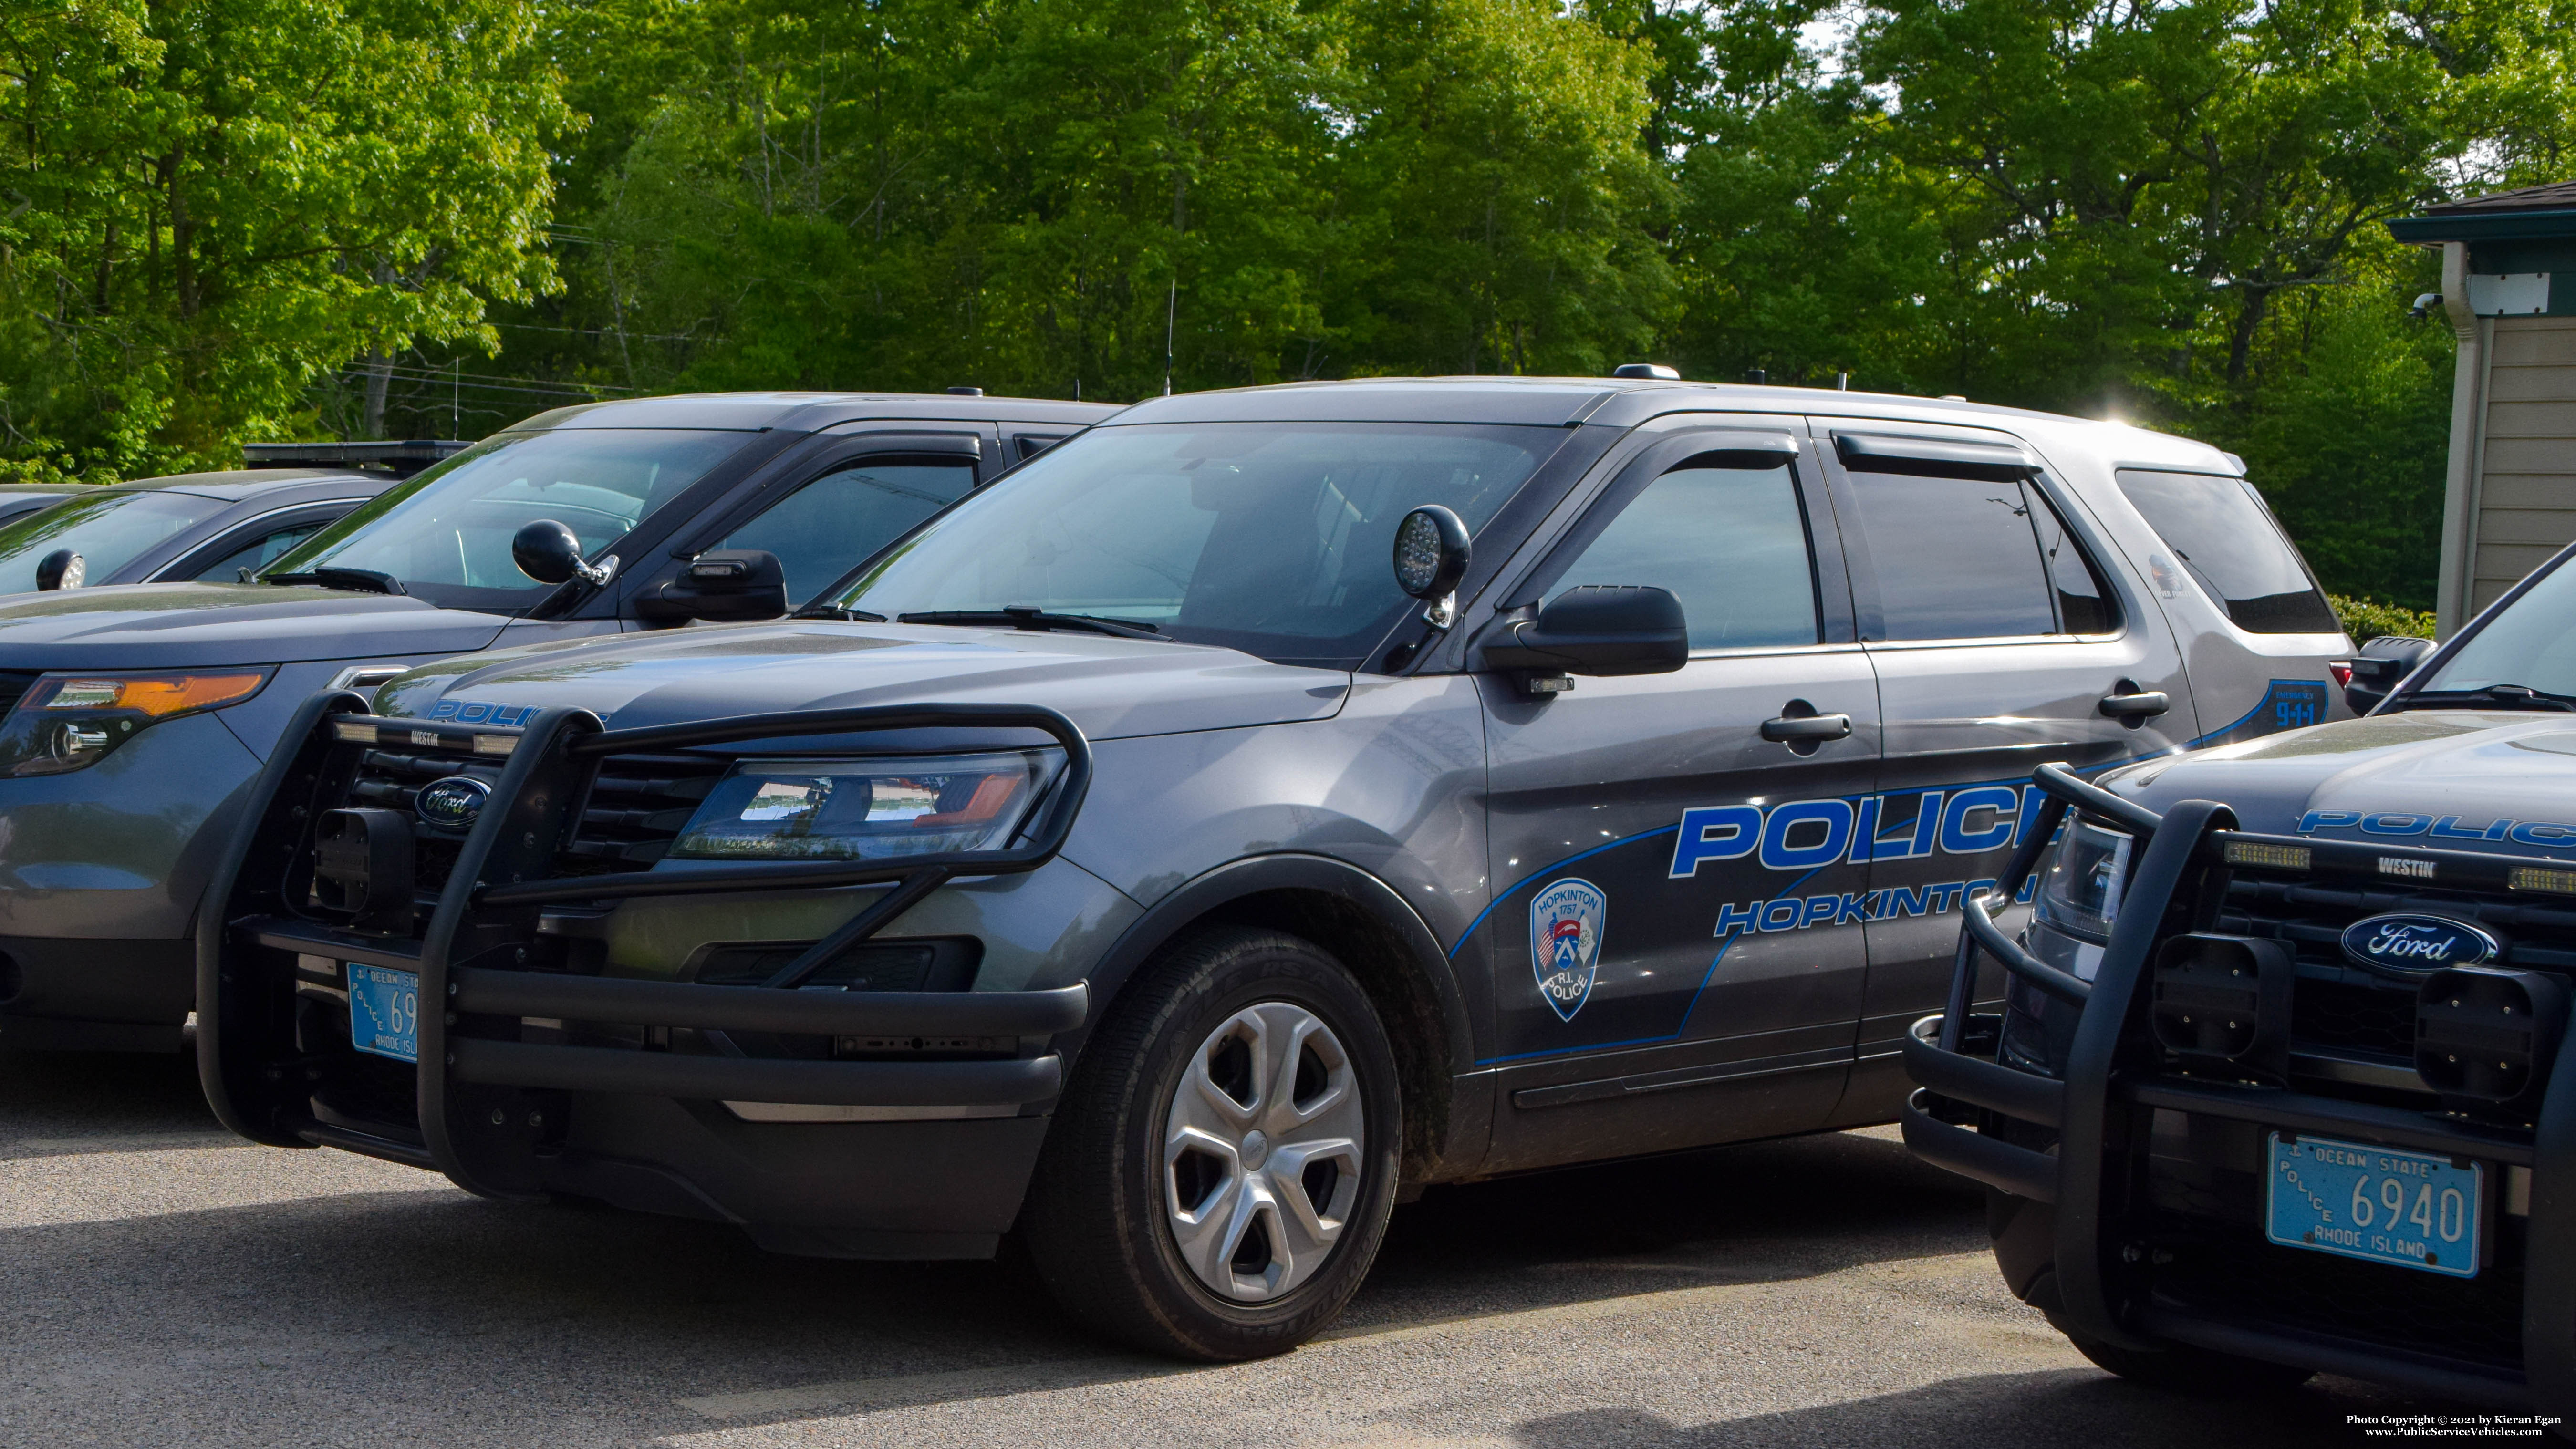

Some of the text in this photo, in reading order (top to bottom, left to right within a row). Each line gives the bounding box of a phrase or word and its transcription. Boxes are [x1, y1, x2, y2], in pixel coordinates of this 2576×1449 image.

[426, 783, 471, 814] Ford
[2296, 809, 2576, 848] POLIC
[1538, 890, 1598, 914] HOPKINTON
[1559, 904, 1577, 915] 1757
[2369, 922, 2456, 961] Ford
[371, 971, 418, 988] OCEAN STA
[1546, 974, 1588, 1000] POLICE
[1558, 972, 1573, 984] R.I.
[353, 983, 383, 1031] POLICE
[392, 990, 416, 1035] 69
[375, 1034, 418, 1054] RHODE ISL
[2316, 1148, 2429, 1178] OCEAN STATE
[2280, 1161, 2332, 1222] POLICE
[2351, 1174, 2464, 1242] 6940
[2315, 1225, 2426, 1259] RHODE ISLAND
